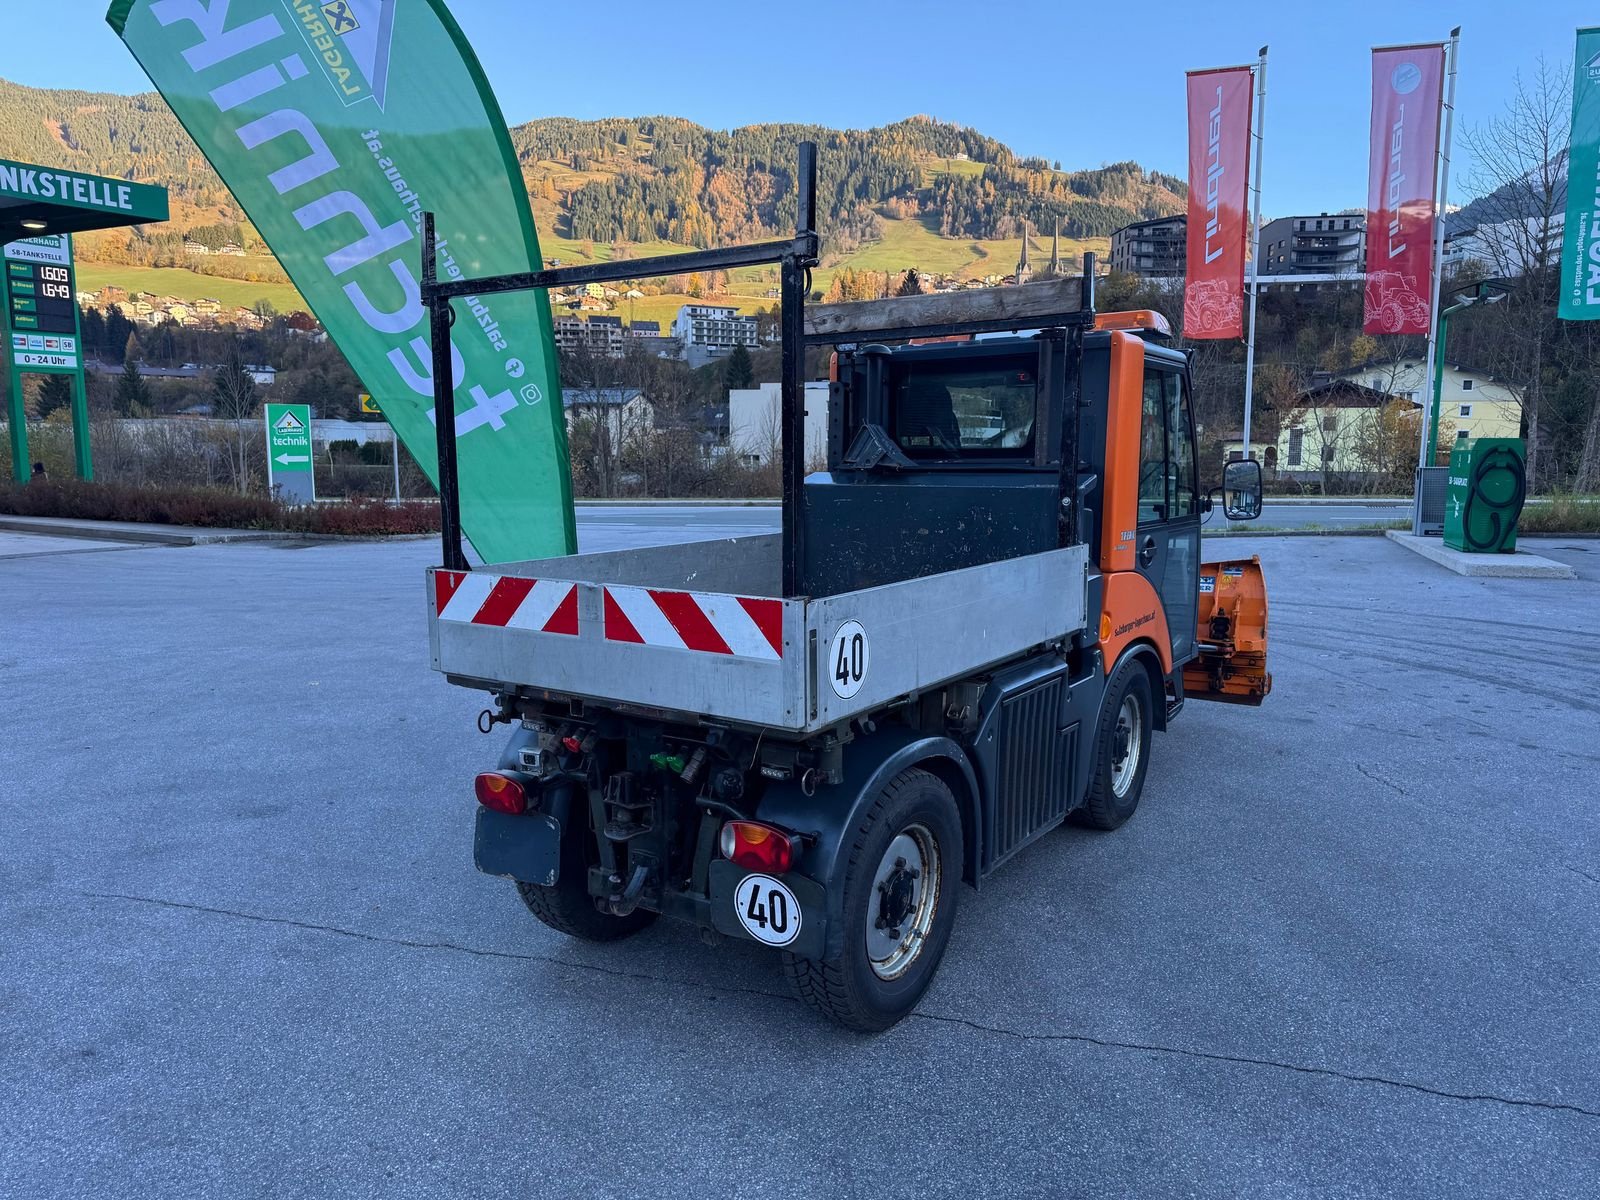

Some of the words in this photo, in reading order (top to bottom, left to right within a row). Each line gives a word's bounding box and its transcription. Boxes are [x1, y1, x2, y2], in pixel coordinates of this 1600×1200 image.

[11, 249, 63, 261] SB-TANKSTELLE
[41, 266, 68, 282] 1.609
[42, 283, 70, 299] 1.649
[38, 356, 49, 364] 24
[51, 356, 66, 365] Uhr
[273, 436, 308, 446] technik
[835, 632, 864, 686] 40
[746, 884, 788, 933] 40
